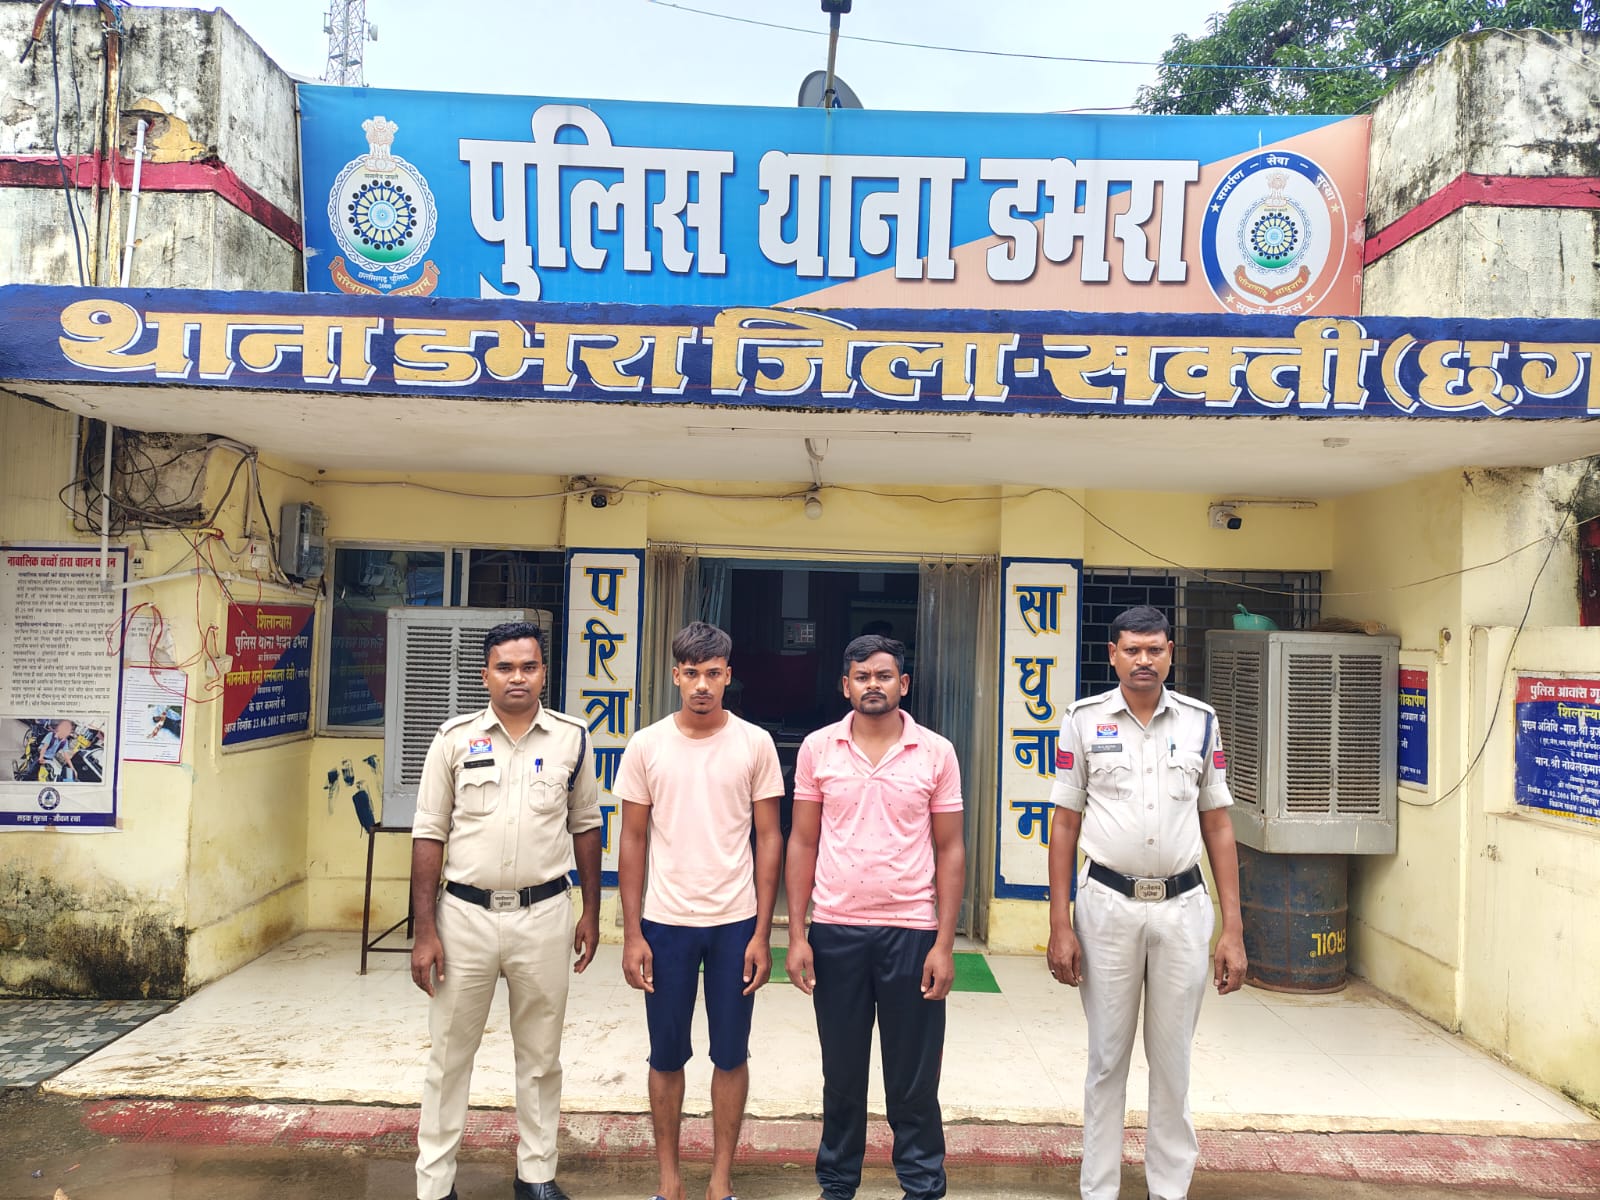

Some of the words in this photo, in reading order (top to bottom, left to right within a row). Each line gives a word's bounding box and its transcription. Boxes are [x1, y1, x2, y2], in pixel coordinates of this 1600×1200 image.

[1266, 154, 1290, 166] सेवा
[458, 104, 734, 300] पुलिस
[759, 150, 966, 280] थाना
[979, 155, 1200, 284] डभरा
[59, 299, 384, 380] थाना
[393, 316, 697, 395] डभरा
[256, 608, 292, 630] शिलान्यास
[235, 630, 257, 656] पुलिस
[1530, 681, 1555, 700] पुलिस
[1557, 686, 1587, 699] आवास
[1551, 755, 1560, 768] श्री
